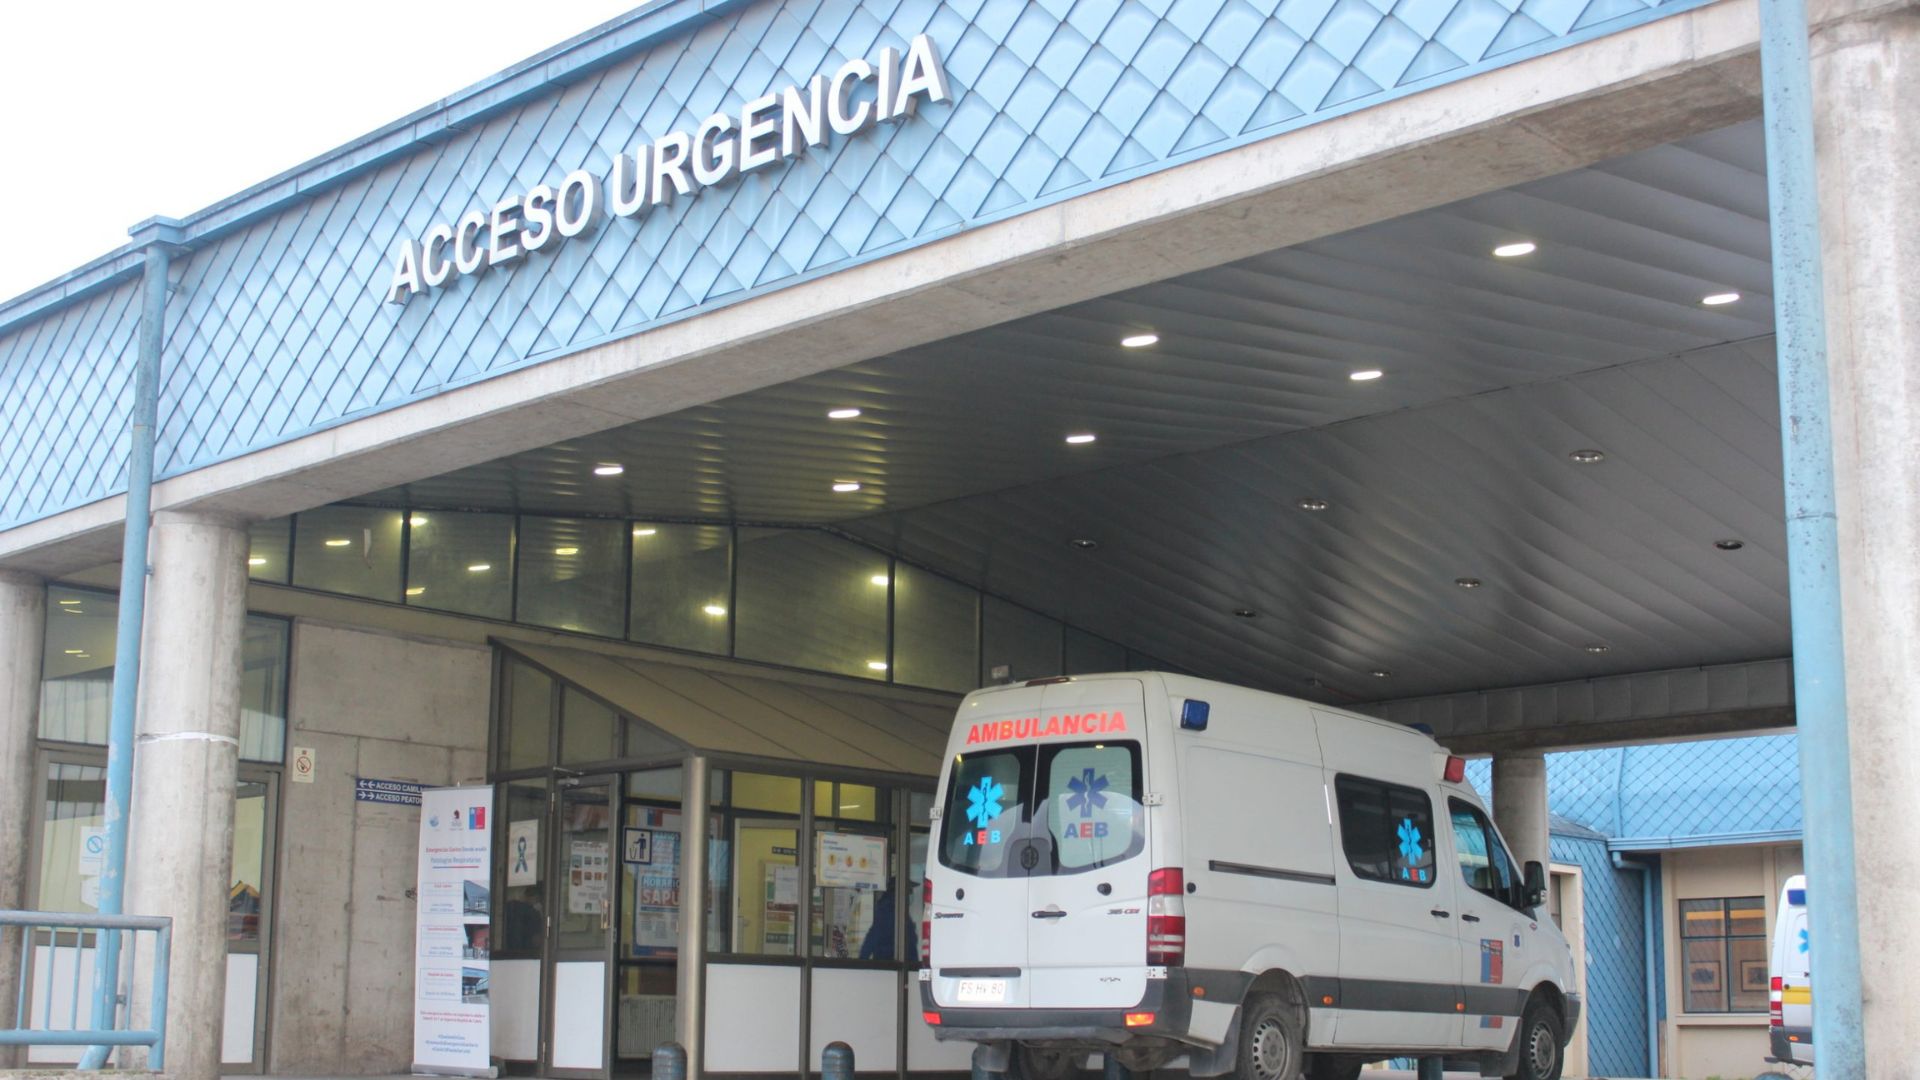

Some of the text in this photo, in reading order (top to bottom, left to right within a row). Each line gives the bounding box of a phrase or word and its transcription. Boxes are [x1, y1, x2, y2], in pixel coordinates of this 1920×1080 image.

[388, 33, 953, 305] ACCESO URGENCIA
[966, 710, 1128, 745] AMBULANCIA
[375, 782, 402, 791] ACCESO
[375, 793, 401, 802] ACCESO
[1064, 821, 1109, 839] AEB
[1402, 867, 1426, 882] AEB
